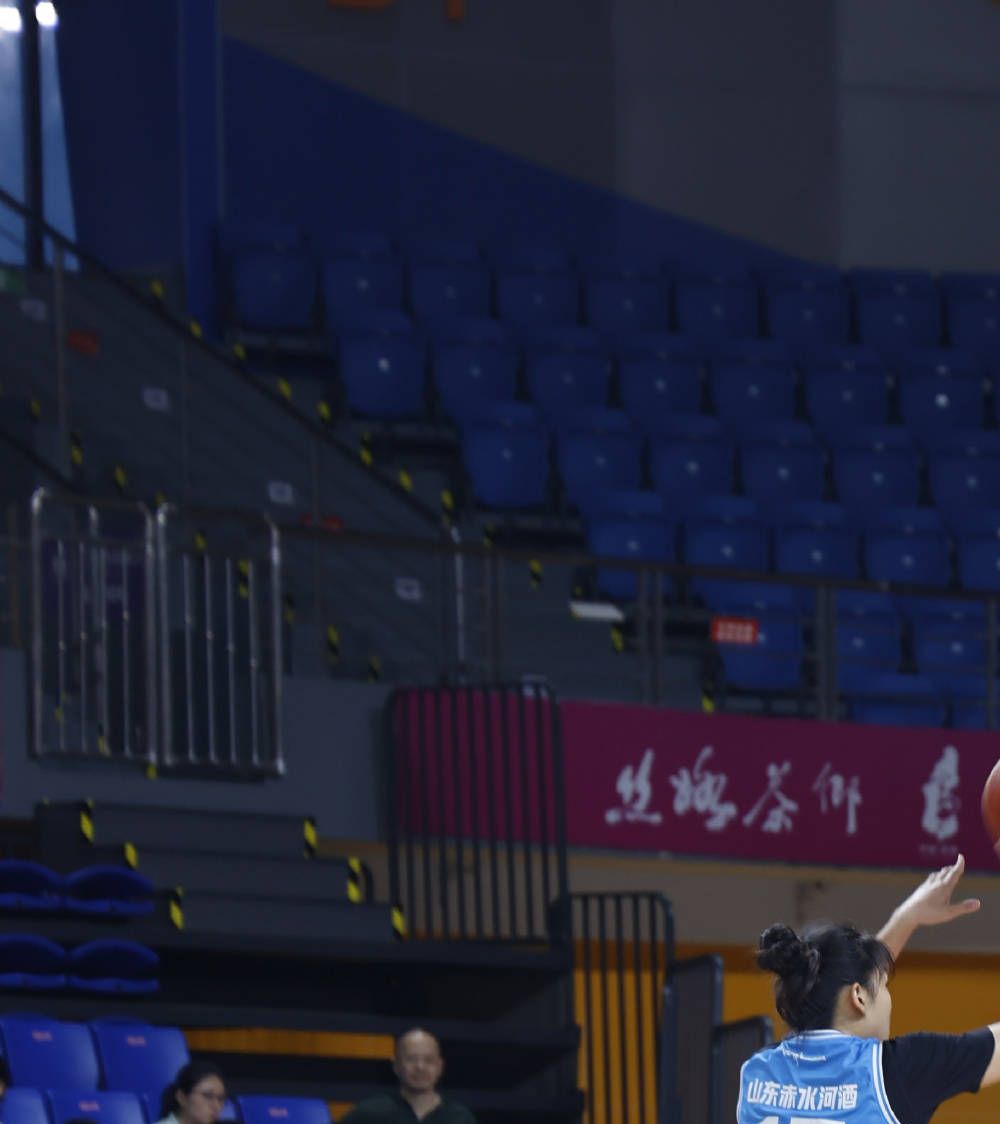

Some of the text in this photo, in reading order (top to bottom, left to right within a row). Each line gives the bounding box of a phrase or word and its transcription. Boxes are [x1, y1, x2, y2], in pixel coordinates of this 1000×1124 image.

[746, 1077, 859, 1112] 山东赤水河酒
